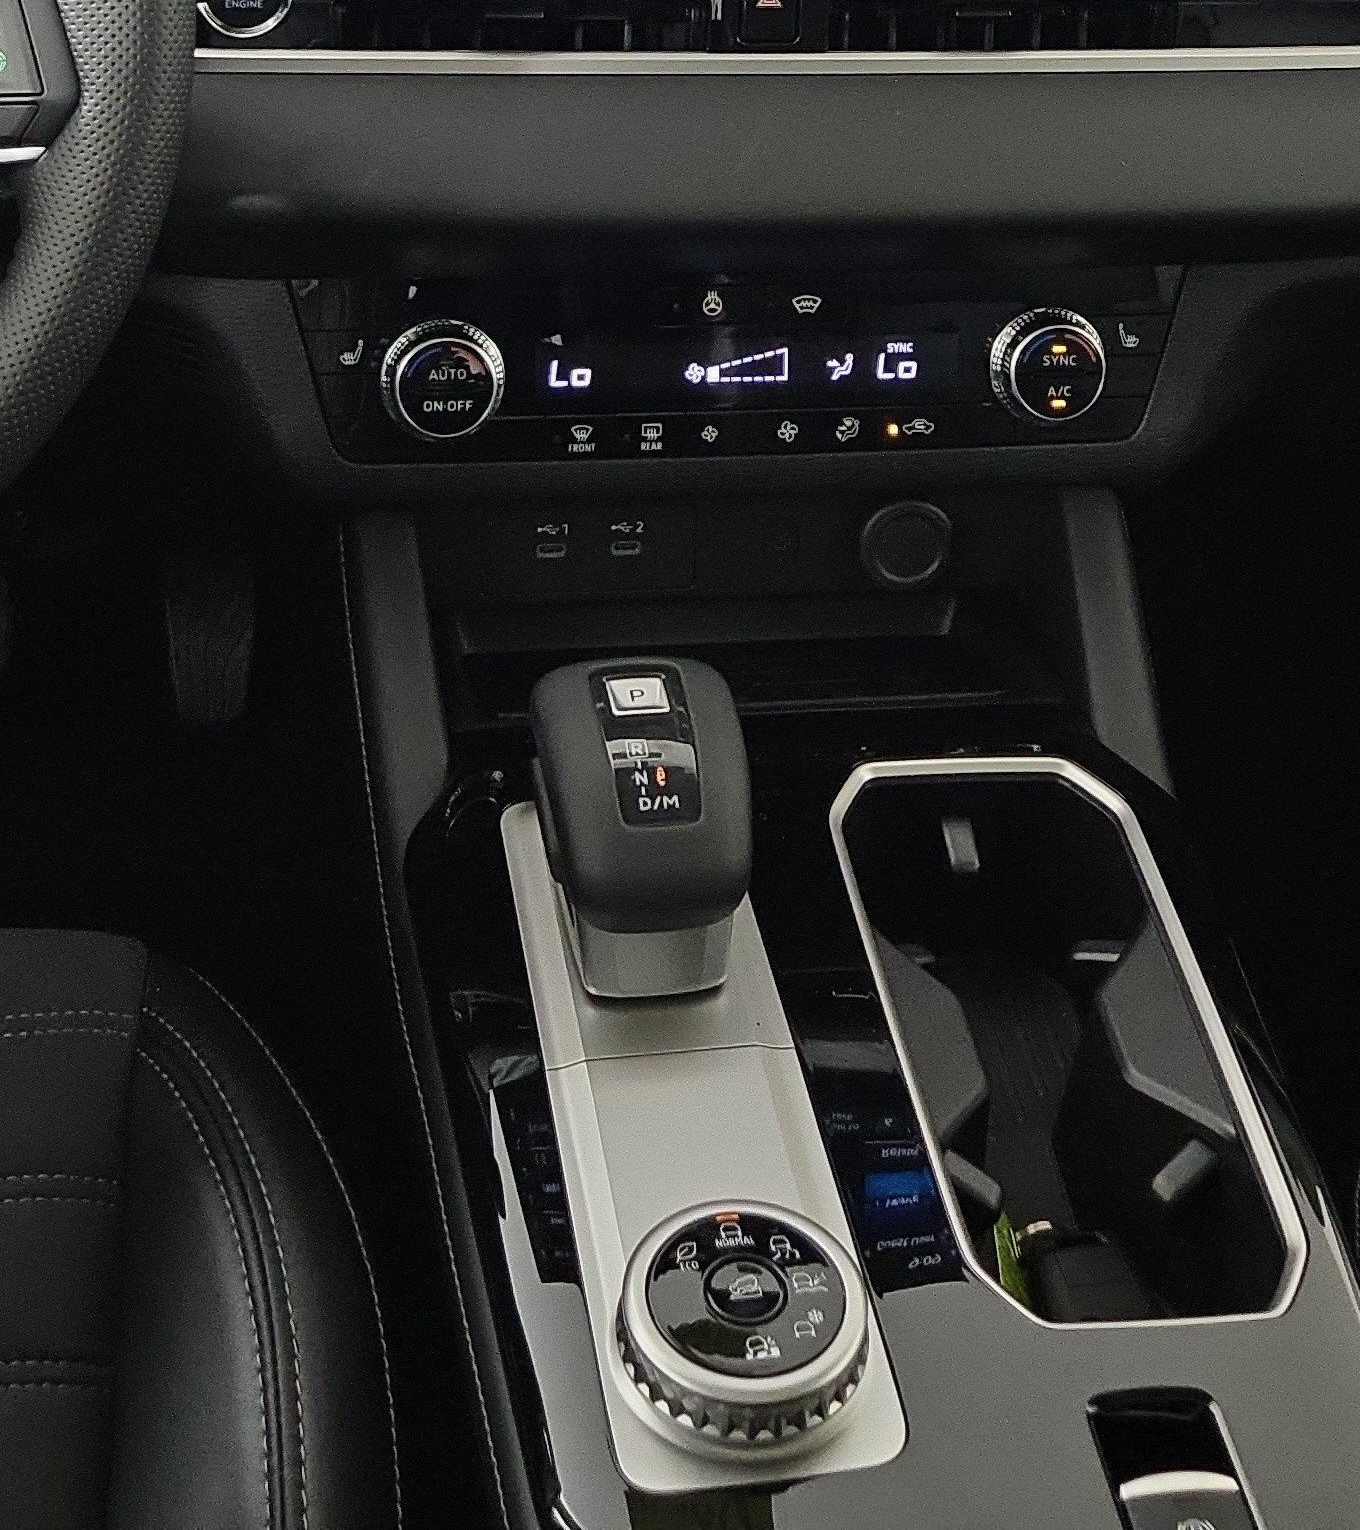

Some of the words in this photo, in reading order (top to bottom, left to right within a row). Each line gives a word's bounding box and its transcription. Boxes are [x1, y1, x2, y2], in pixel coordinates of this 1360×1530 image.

[225, 0, 264, 9] ENGINE
[886, 342, 913, 353] SYNC
[1042, 355, 1077, 368] SYNC
[428, 368, 467, 381] AUTO
[1047, 385, 1072, 398] A/C
[568, 443, 596, 453] FRONT
[641, 441, 662, 451] REAR
[636, 521, 644, 533] 2
[629, 689, 645, 702] P
[631, 744, 644, 755] R
[634, 771, 649, 785] N
[639, 795, 680, 811] D/M
[714, 1235, 756, 1248] NORMAL
[680, 1260, 700, 1271] ECO
